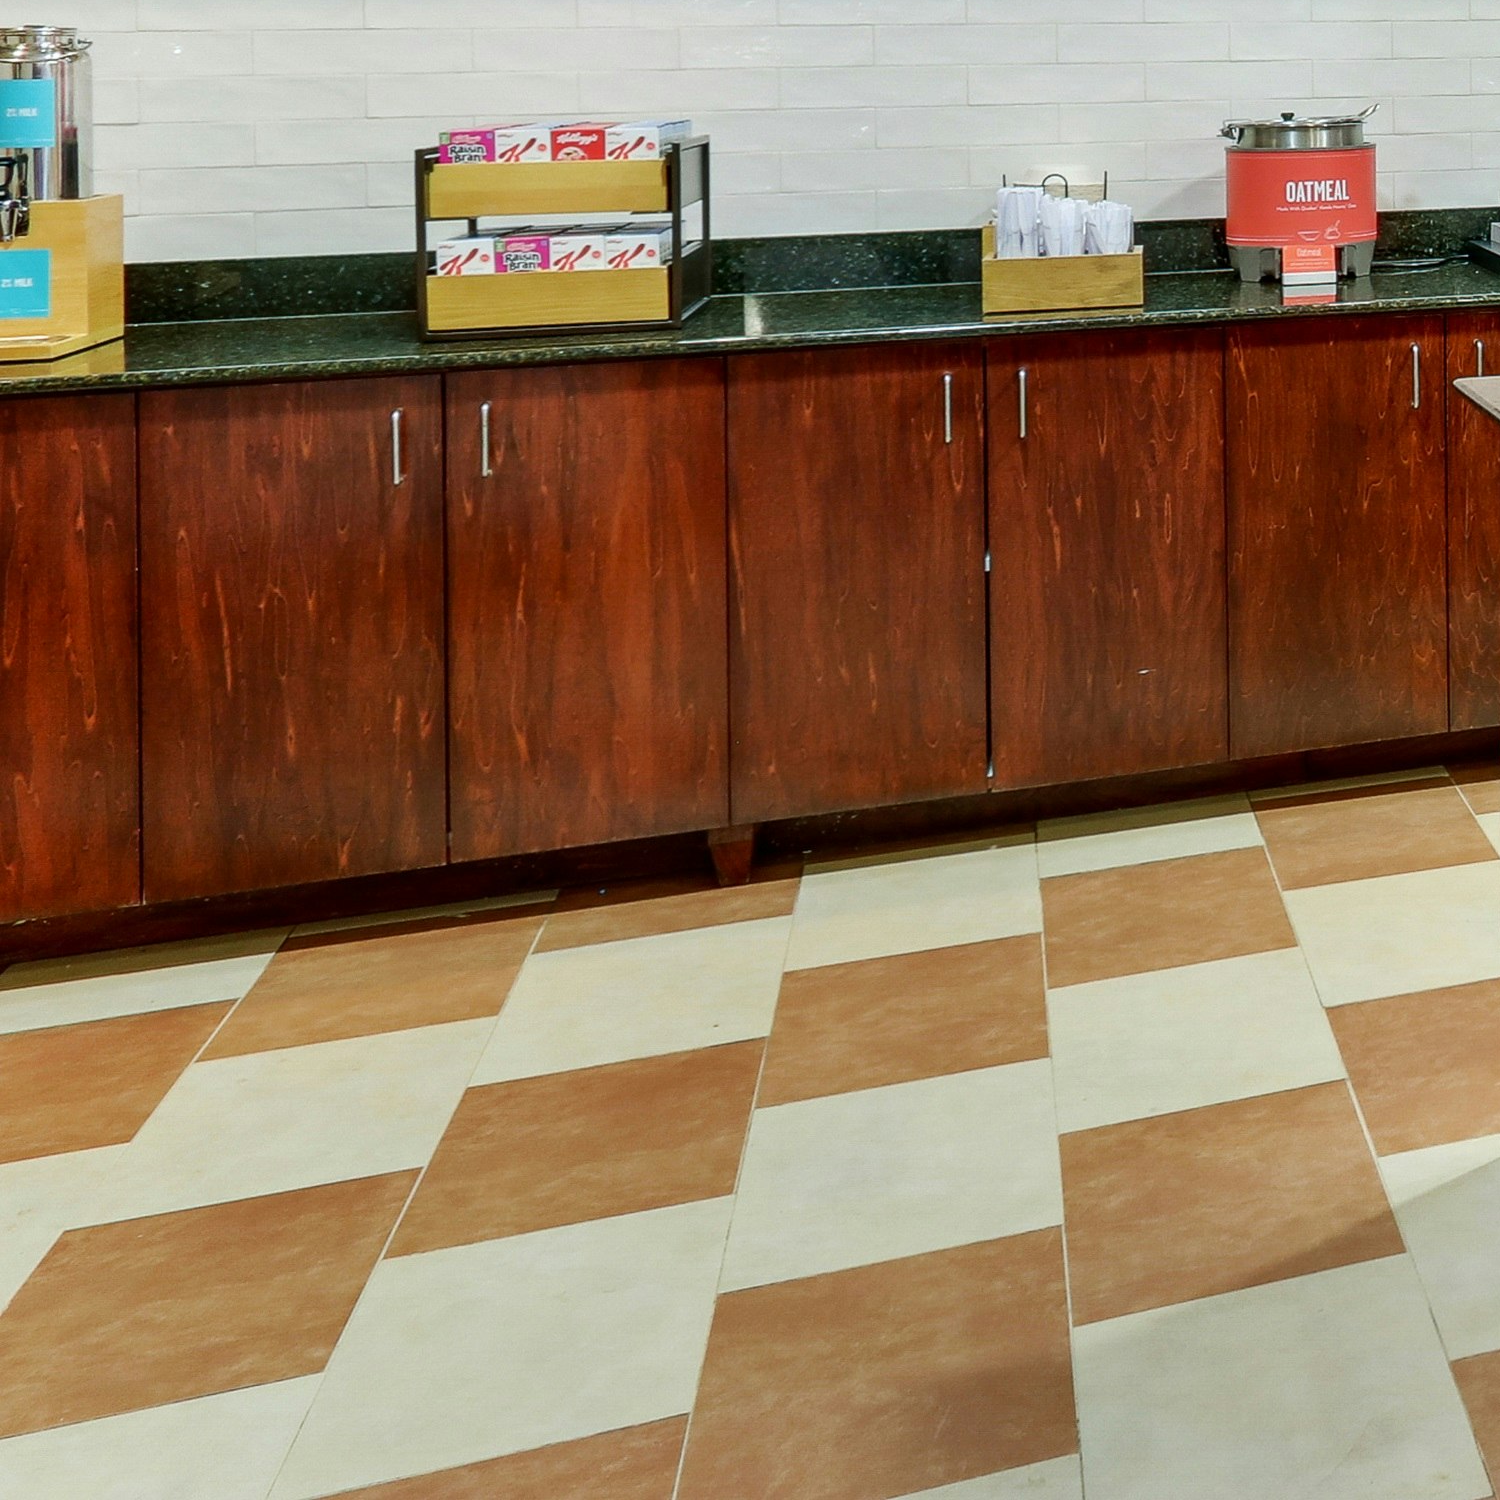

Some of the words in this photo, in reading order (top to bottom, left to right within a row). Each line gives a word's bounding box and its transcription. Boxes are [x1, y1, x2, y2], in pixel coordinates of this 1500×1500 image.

[556, 132, 599, 145] Kellogg's
[450, 145, 485, 154] Raisin
[454, 154, 481, 163] Bran
[1285, 179, 1350, 203] OATMEAL
[505, 254, 540, 262] Raisin
[508, 261, 536, 270] Bran
